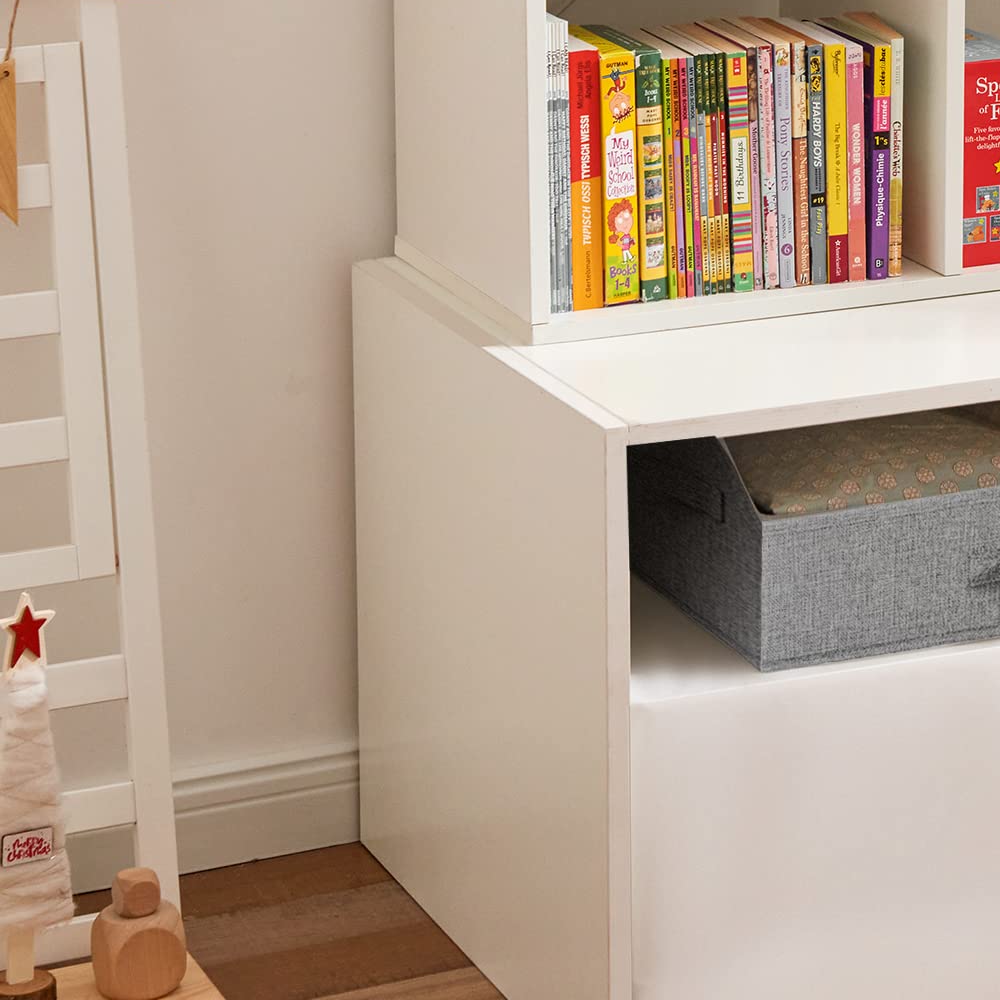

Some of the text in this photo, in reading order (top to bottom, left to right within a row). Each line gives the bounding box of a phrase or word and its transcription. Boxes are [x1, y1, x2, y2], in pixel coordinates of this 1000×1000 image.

[665, 67, 670, 76] MY
[673, 69, 678, 78] MY
[681, 68, 686, 76] MY
[689, 67, 694, 75] MY
[979, 104, 989, 114] of
[812, 101, 821, 137] HARDY
[611, 138, 629, 150] My
[892, 121, 902, 177] Charlotte's Web
[607, 149, 633, 168] Weird
[777, 117, 791, 191] Pony Stories
[813, 140, 822, 167] BOYS
[735, 142, 746, 200] 11 Birthdays
[852, 123, 861, 204] WONDER WOMEN
[580, 115, 591, 245] TYPISCH OSSI TYPISCH WESSI
[608, 167, 634, 184] School
[799, 157, 808, 200] Naughtiest
[875, 153, 886, 227] Physique-Chimie
[801, 202, 809, 217] Girl
[801, 219, 808, 228] in
[801, 229, 809, 242] the
[801, 244, 809, 272] School
[609, 263, 637, 278] Books
[615, 277, 630, 291] 1-4
